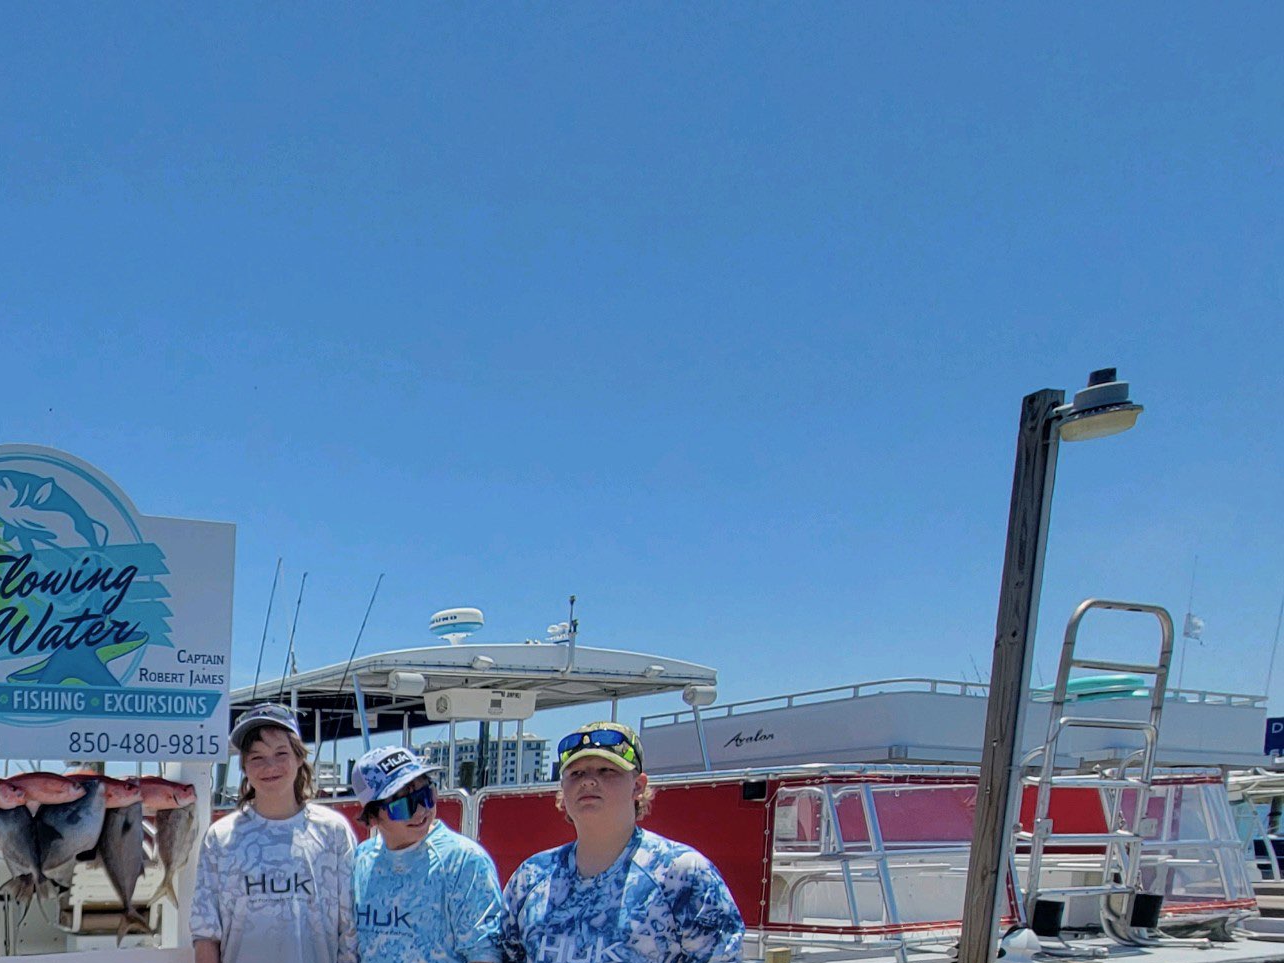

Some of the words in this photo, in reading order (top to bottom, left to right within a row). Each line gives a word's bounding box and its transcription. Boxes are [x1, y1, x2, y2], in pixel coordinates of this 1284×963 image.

[13, 690, 86, 711] FISHING
[104, 693, 207, 715] EXCURSIONS
[69, 732, 220, 755] 850-480-9815
[723, 729, 775, 748] Avalon
